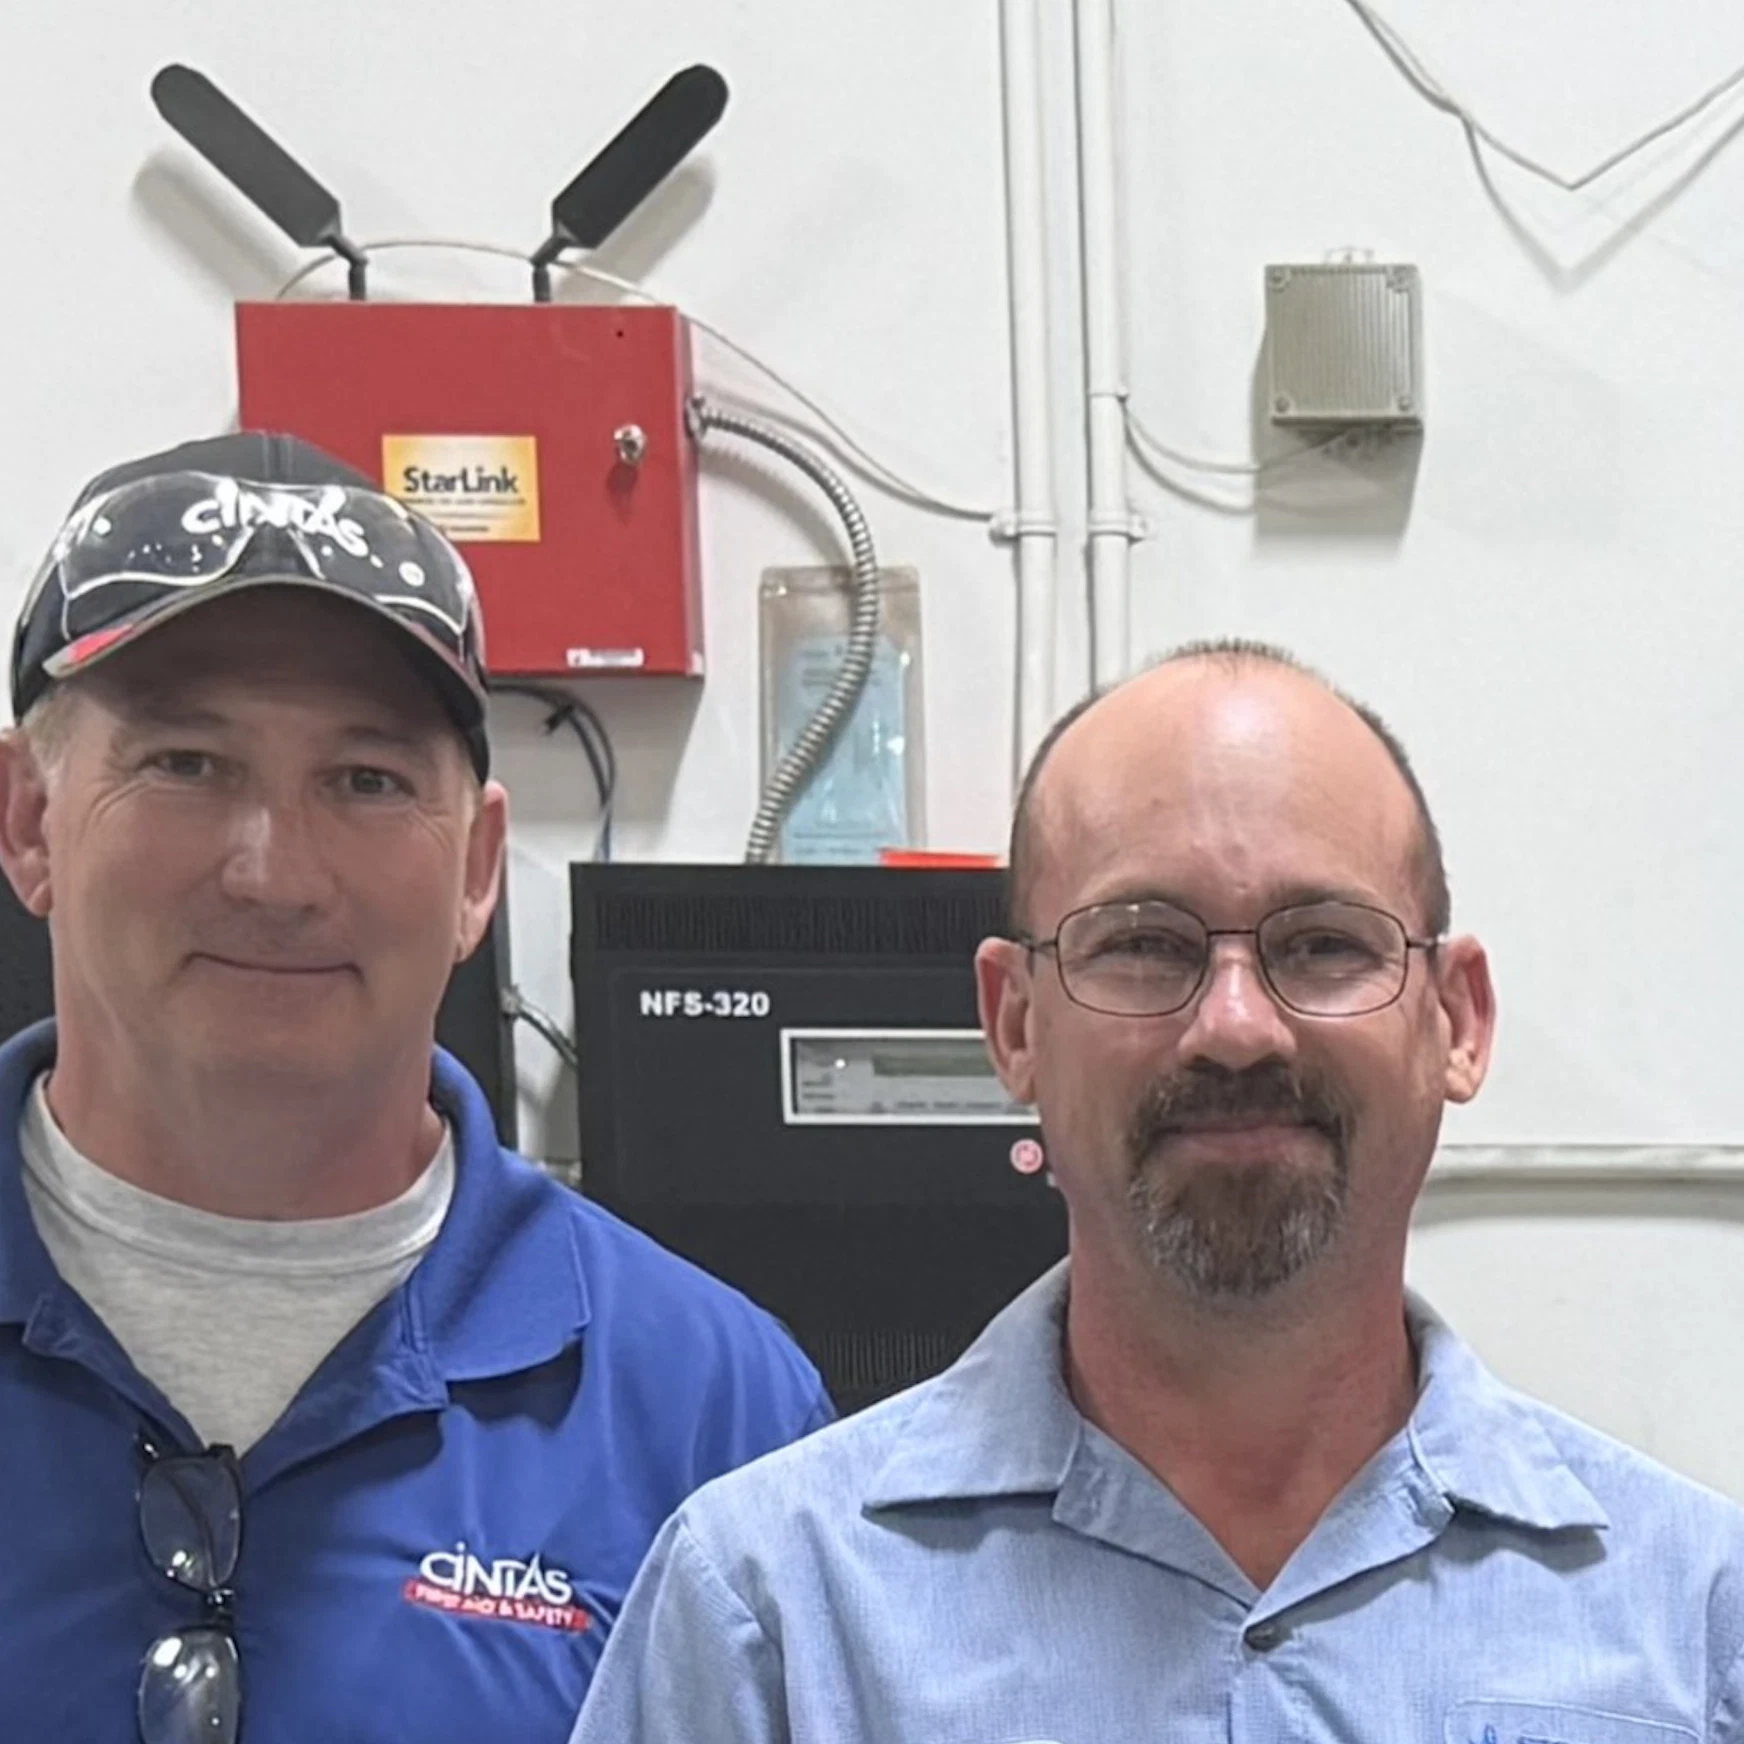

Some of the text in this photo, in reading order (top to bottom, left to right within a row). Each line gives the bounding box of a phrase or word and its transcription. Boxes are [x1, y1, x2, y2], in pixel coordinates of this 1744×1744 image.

[403, 465, 518, 493] StarLink
[640, 990, 770, 1017] NFS-320
[419, 1541, 573, 1605] CINTAS
